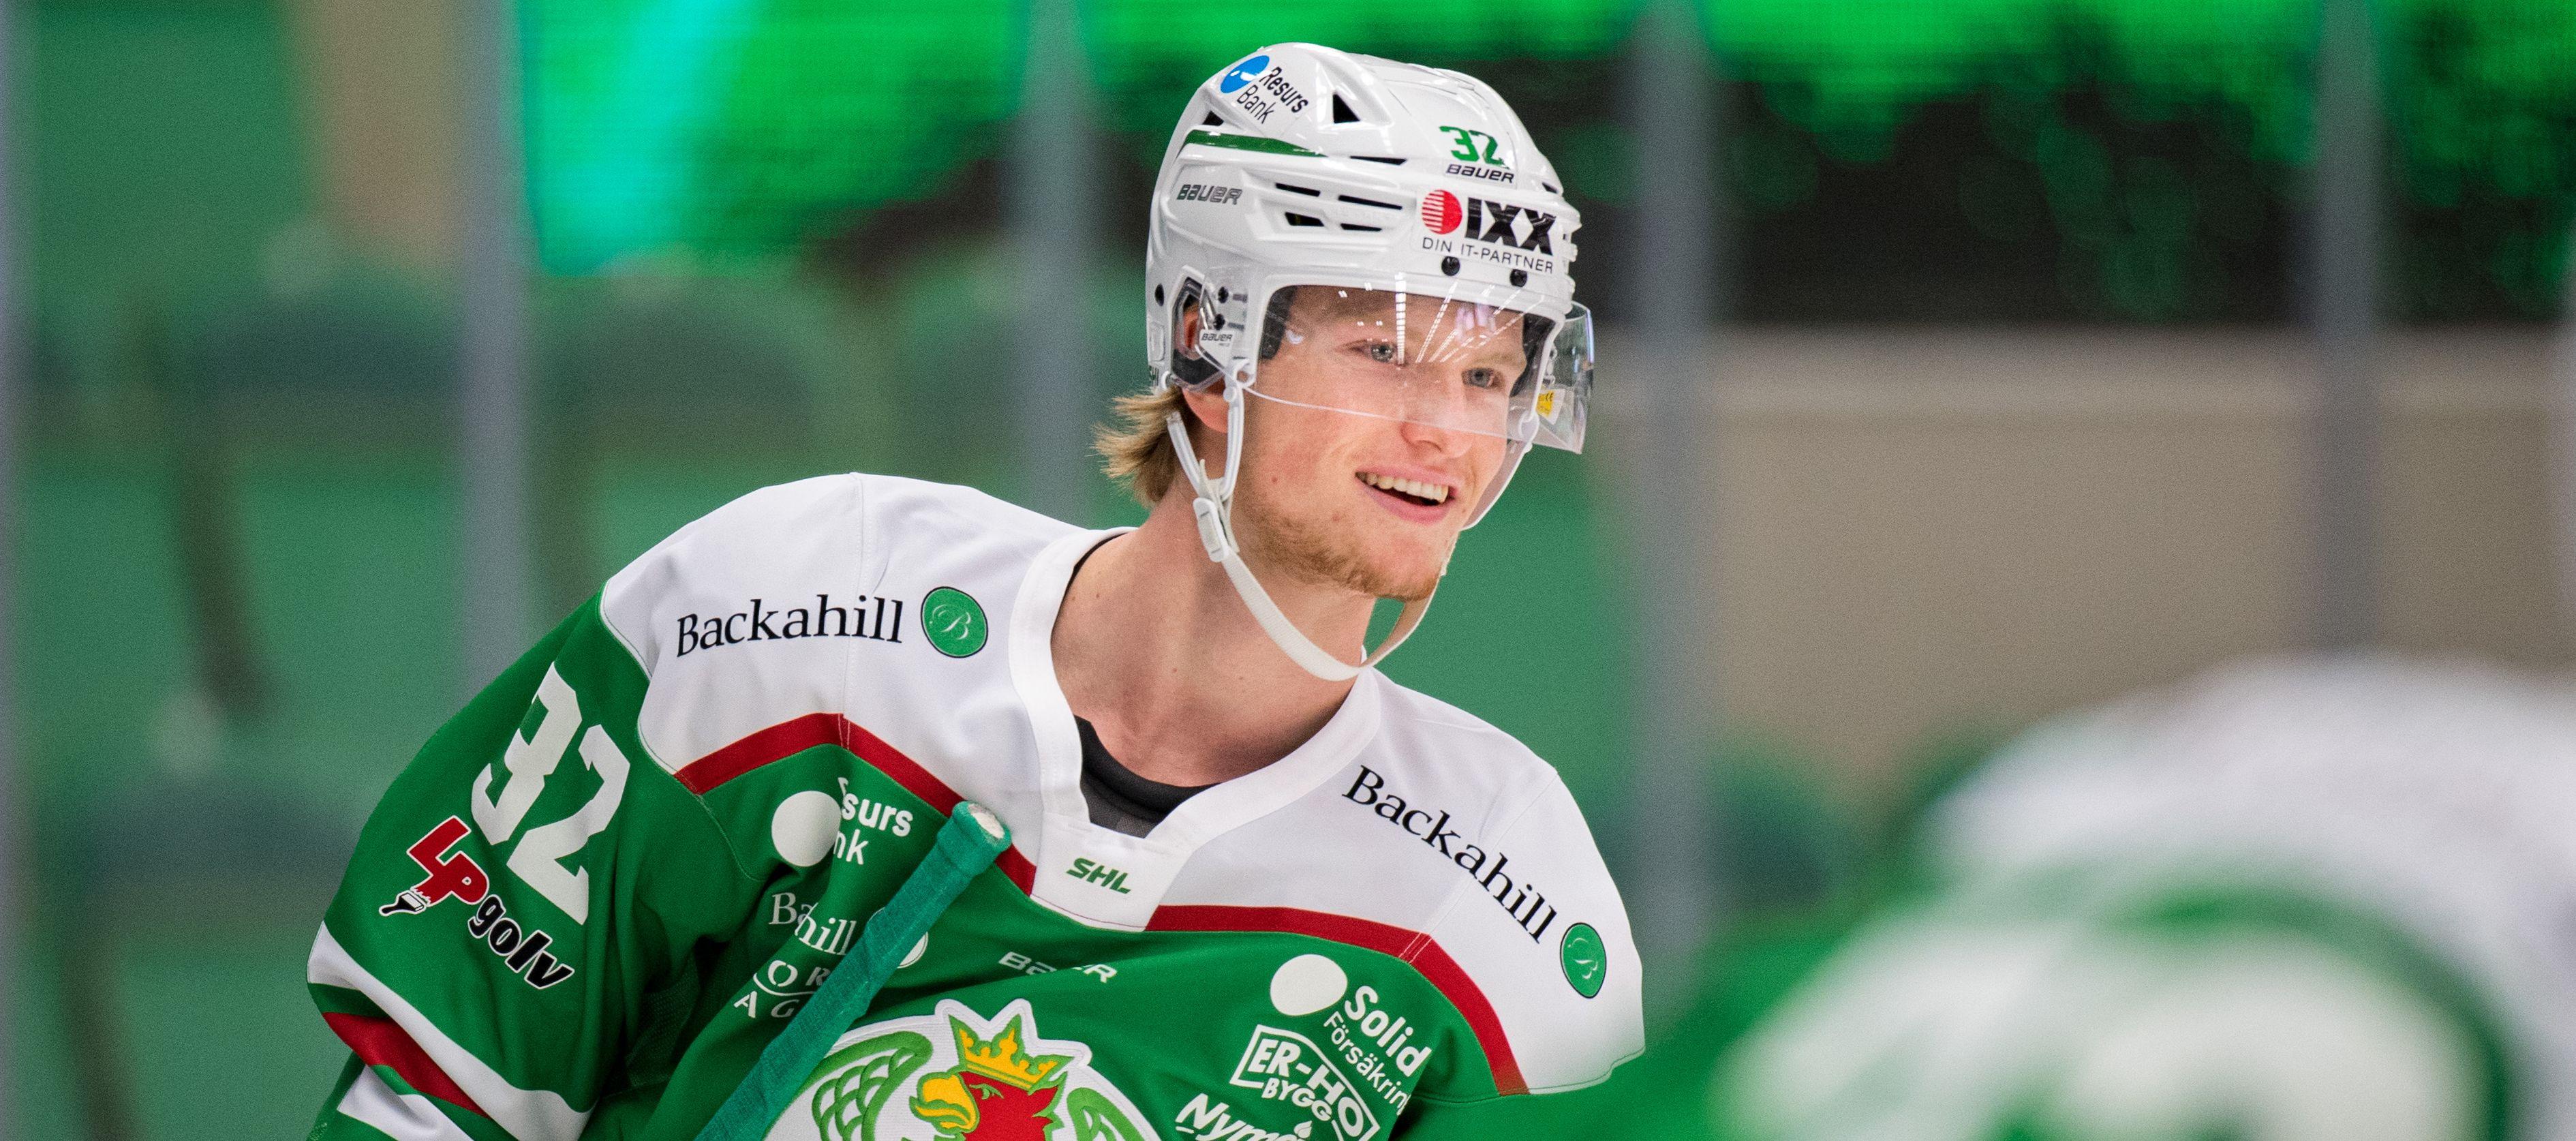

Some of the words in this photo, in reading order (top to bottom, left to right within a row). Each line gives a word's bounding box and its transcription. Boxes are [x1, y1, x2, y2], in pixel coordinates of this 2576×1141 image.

[1237, 85, 1276, 124] Bank
[1259, 66, 1308, 113] Resurs
[1439, 125, 1510, 170] 32
[1422, 237, 1452, 252] DIN
[1460, 244, 1554, 274] IT-PARTNER
[1465, 197, 1557, 256] IXX
[677, 594, 903, 658] Backahill
[471, 661, 630, 926] 32
[406, 815, 489, 907] LP
[1066, 857, 1131, 894] SHL
[1341, 765, 1557, 944] Backahill
[467, 894, 574, 989] golv
[1345, 985, 1432, 1077] Solid
[1261, 1078, 1332, 1121] BYGG
